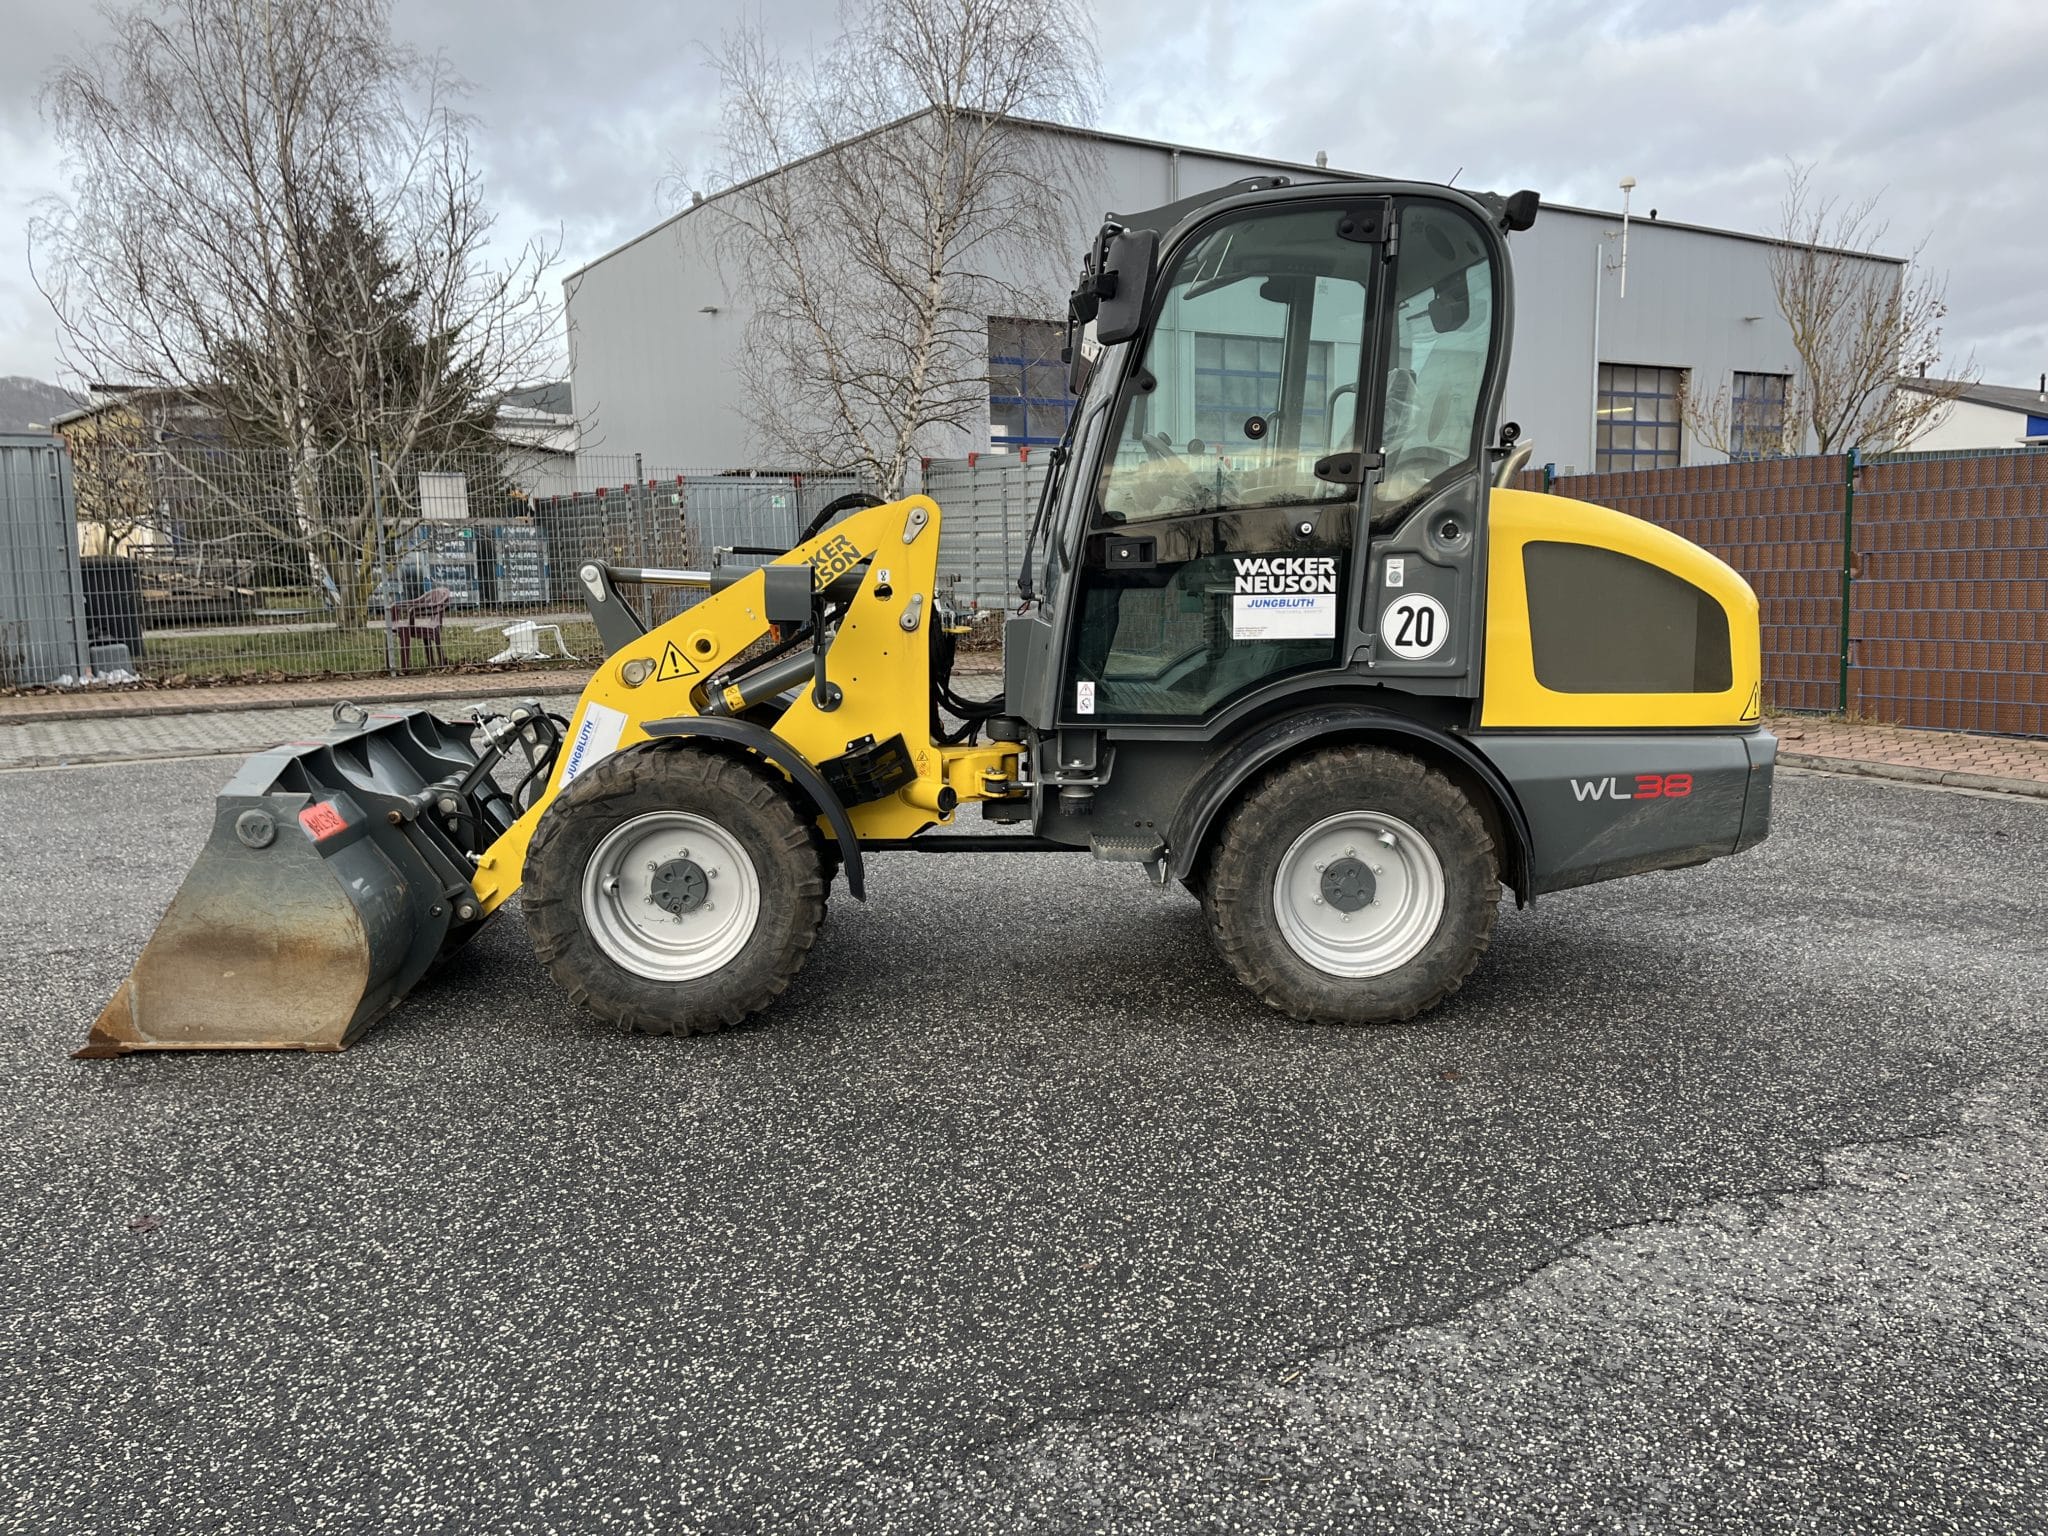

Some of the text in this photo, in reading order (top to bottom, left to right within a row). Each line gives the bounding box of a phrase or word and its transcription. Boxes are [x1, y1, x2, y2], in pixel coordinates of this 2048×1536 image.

[1233, 558, 1336, 575] WACKER
[1235, 575, 1336, 593] NEUSON
[1247, 598, 1316, 608] JUNGBLUTH
[1395, 605, 1435, 648] 20
[567, 720, 593, 779] JUNGBLUTH
[1570, 773, 1693, 802] WL38
